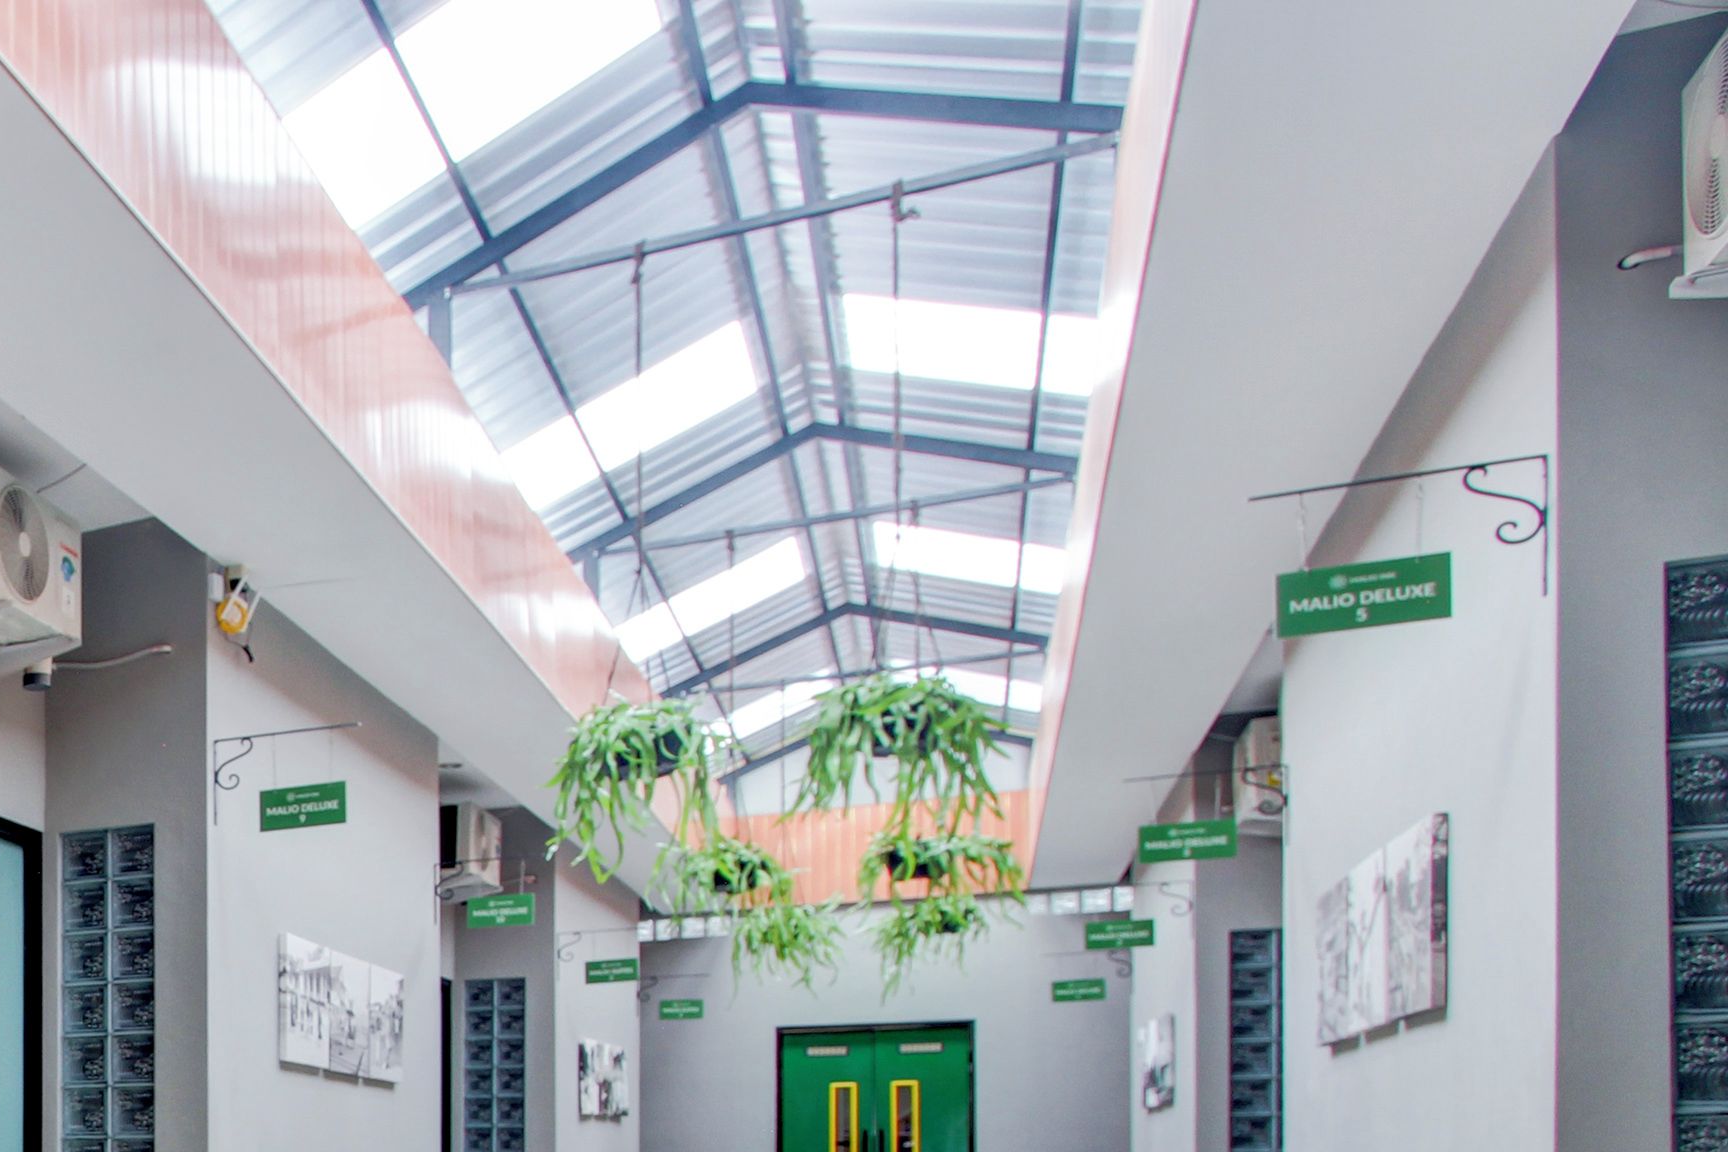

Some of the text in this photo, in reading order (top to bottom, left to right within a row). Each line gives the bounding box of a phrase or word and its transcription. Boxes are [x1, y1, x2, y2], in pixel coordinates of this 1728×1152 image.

[1289, 581, 1437, 614] MALIO DELUXE
[1354, 606, 1369, 622] 5
[266, 799, 339, 817] MALIO DELUXE
